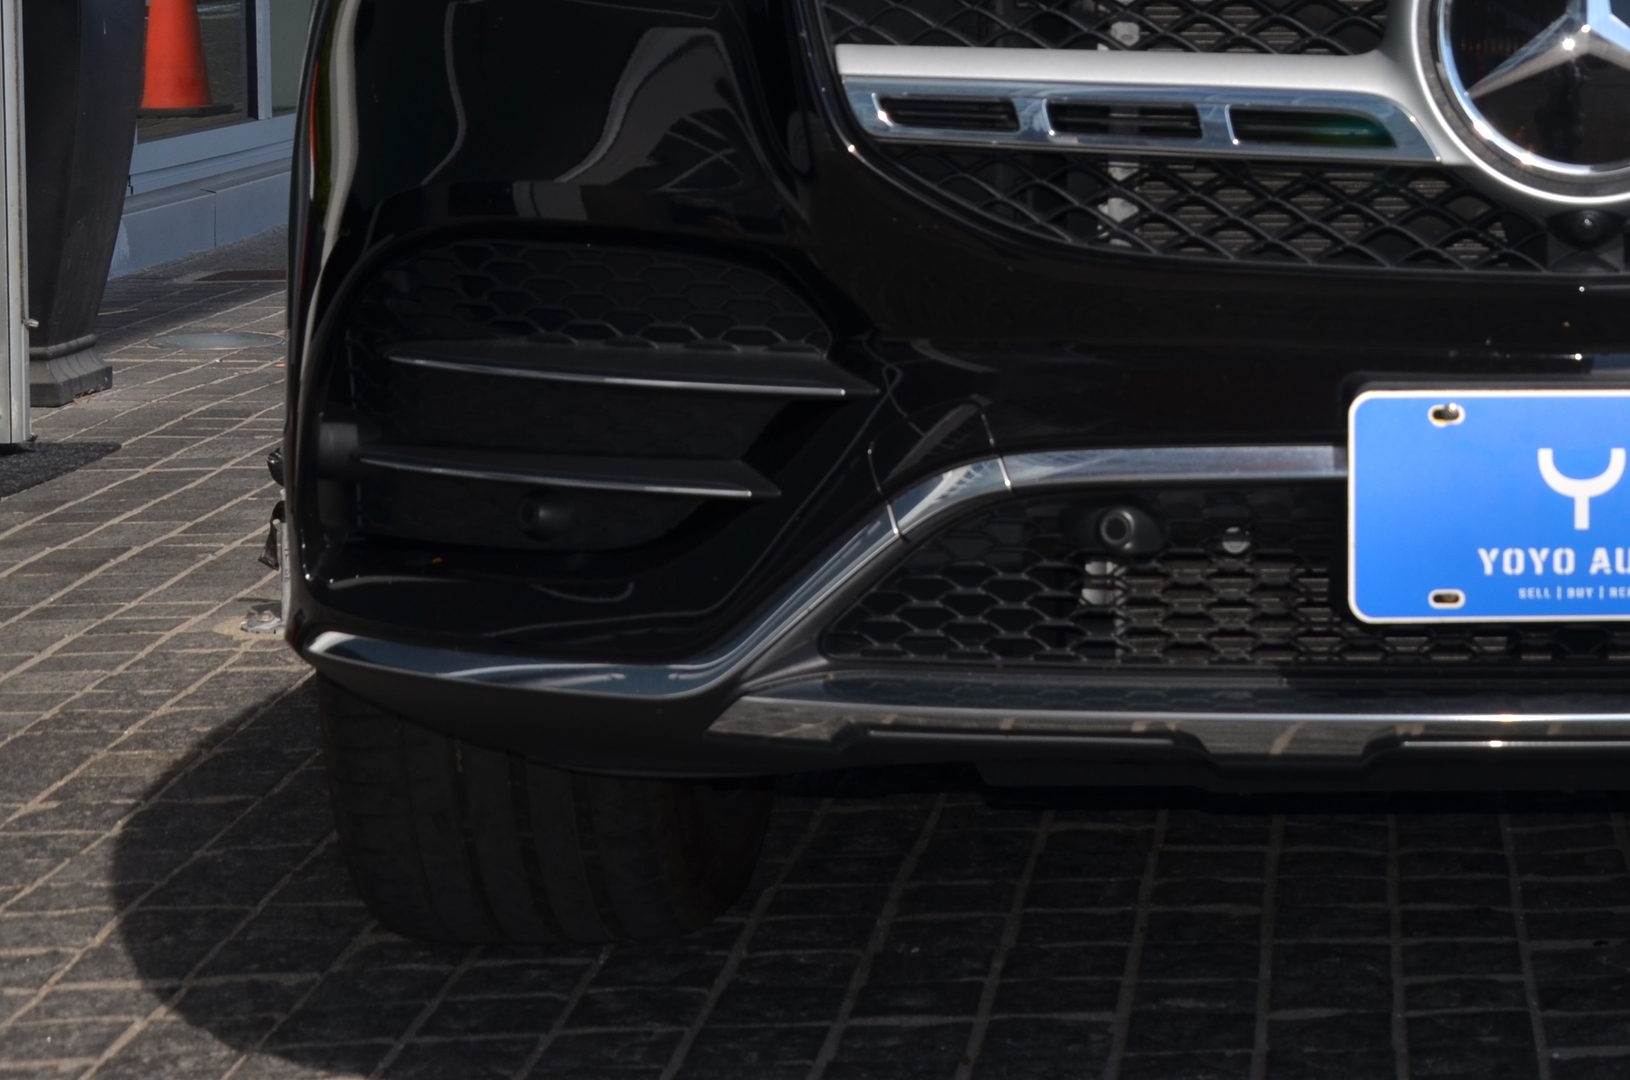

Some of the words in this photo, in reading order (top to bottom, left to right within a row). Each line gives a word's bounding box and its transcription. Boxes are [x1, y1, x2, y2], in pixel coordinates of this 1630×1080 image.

[1478, 547, 1576, 576] YOYO
[1518, 586, 1551, 600] SELL
[1567, 586, 1594, 600] BUY
